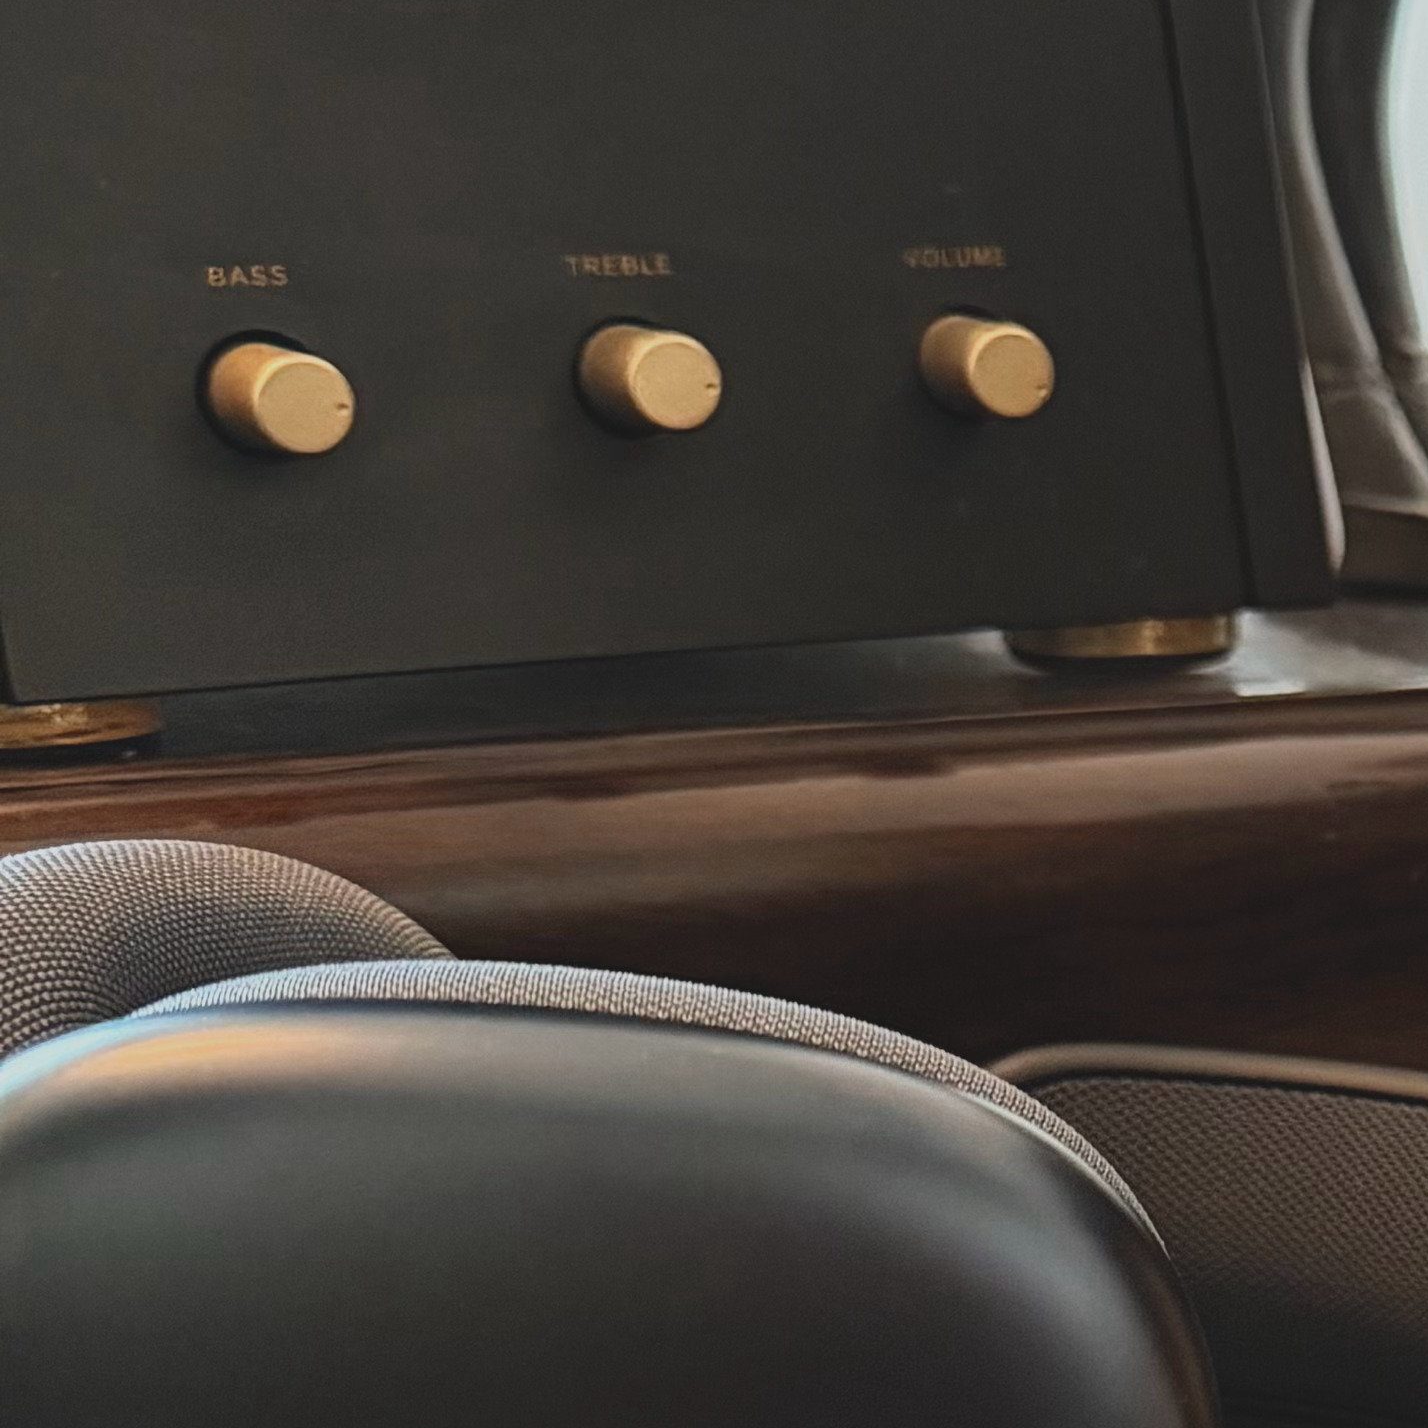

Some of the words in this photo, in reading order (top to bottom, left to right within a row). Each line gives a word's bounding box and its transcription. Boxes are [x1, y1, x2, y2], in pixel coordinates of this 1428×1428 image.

[564, 253, 672, 277] TREBLE
[903, 246, 1006, 268] VOLUME
[207, 264, 289, 287] BASS
